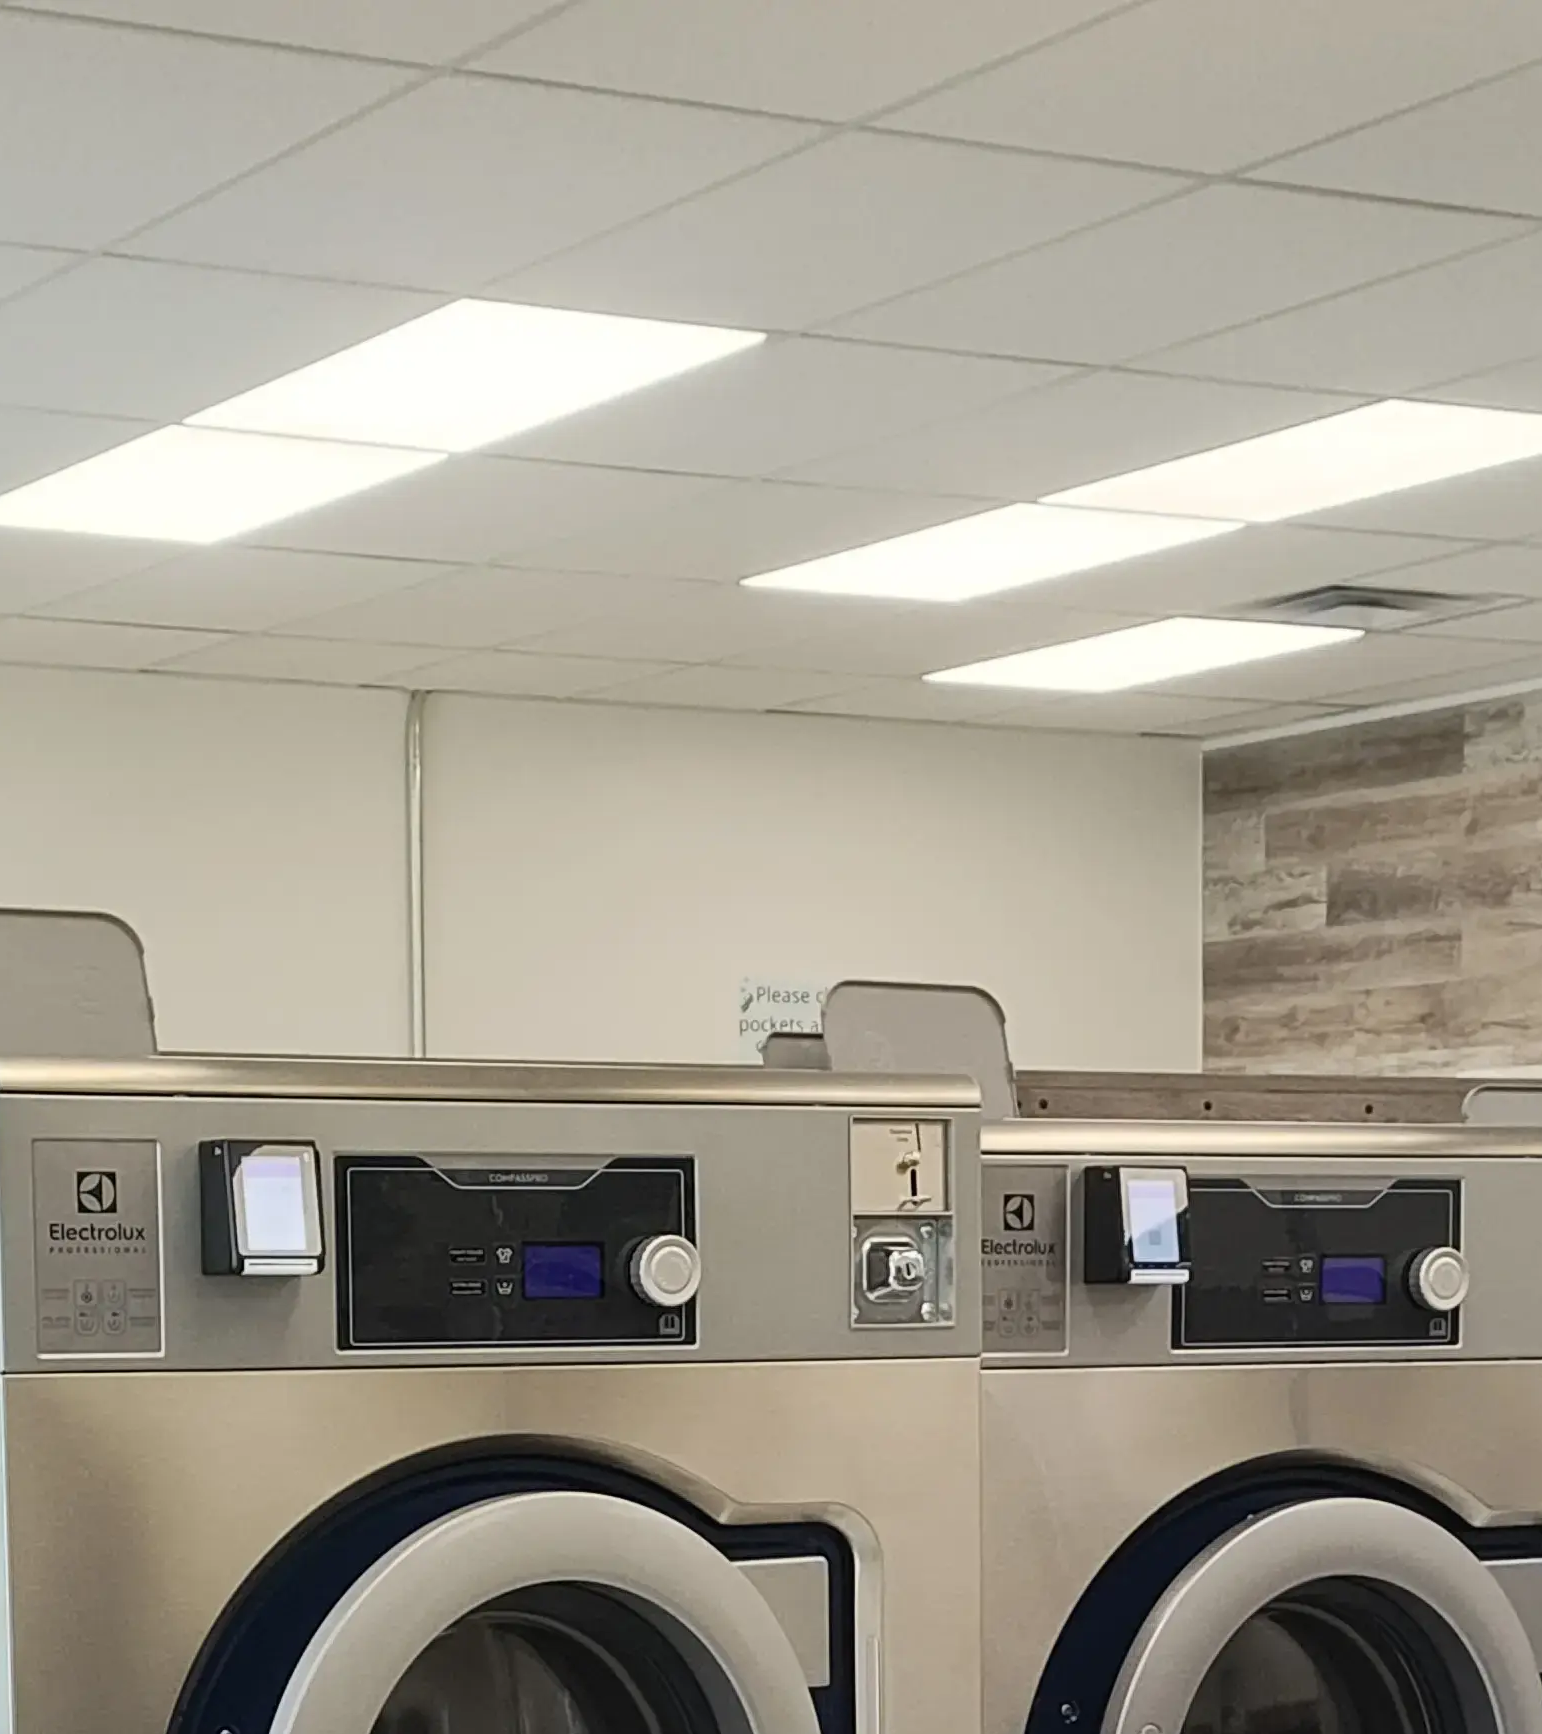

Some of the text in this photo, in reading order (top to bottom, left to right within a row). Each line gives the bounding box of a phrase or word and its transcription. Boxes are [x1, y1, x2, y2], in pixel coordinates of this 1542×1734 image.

[756, 986, 810, 1004] Please
[739, 1016, 804, 1037] pockets
[48, 1223, 146, 1242] Electrolux
[980, 1239, 1056, 1256] Electrolux
